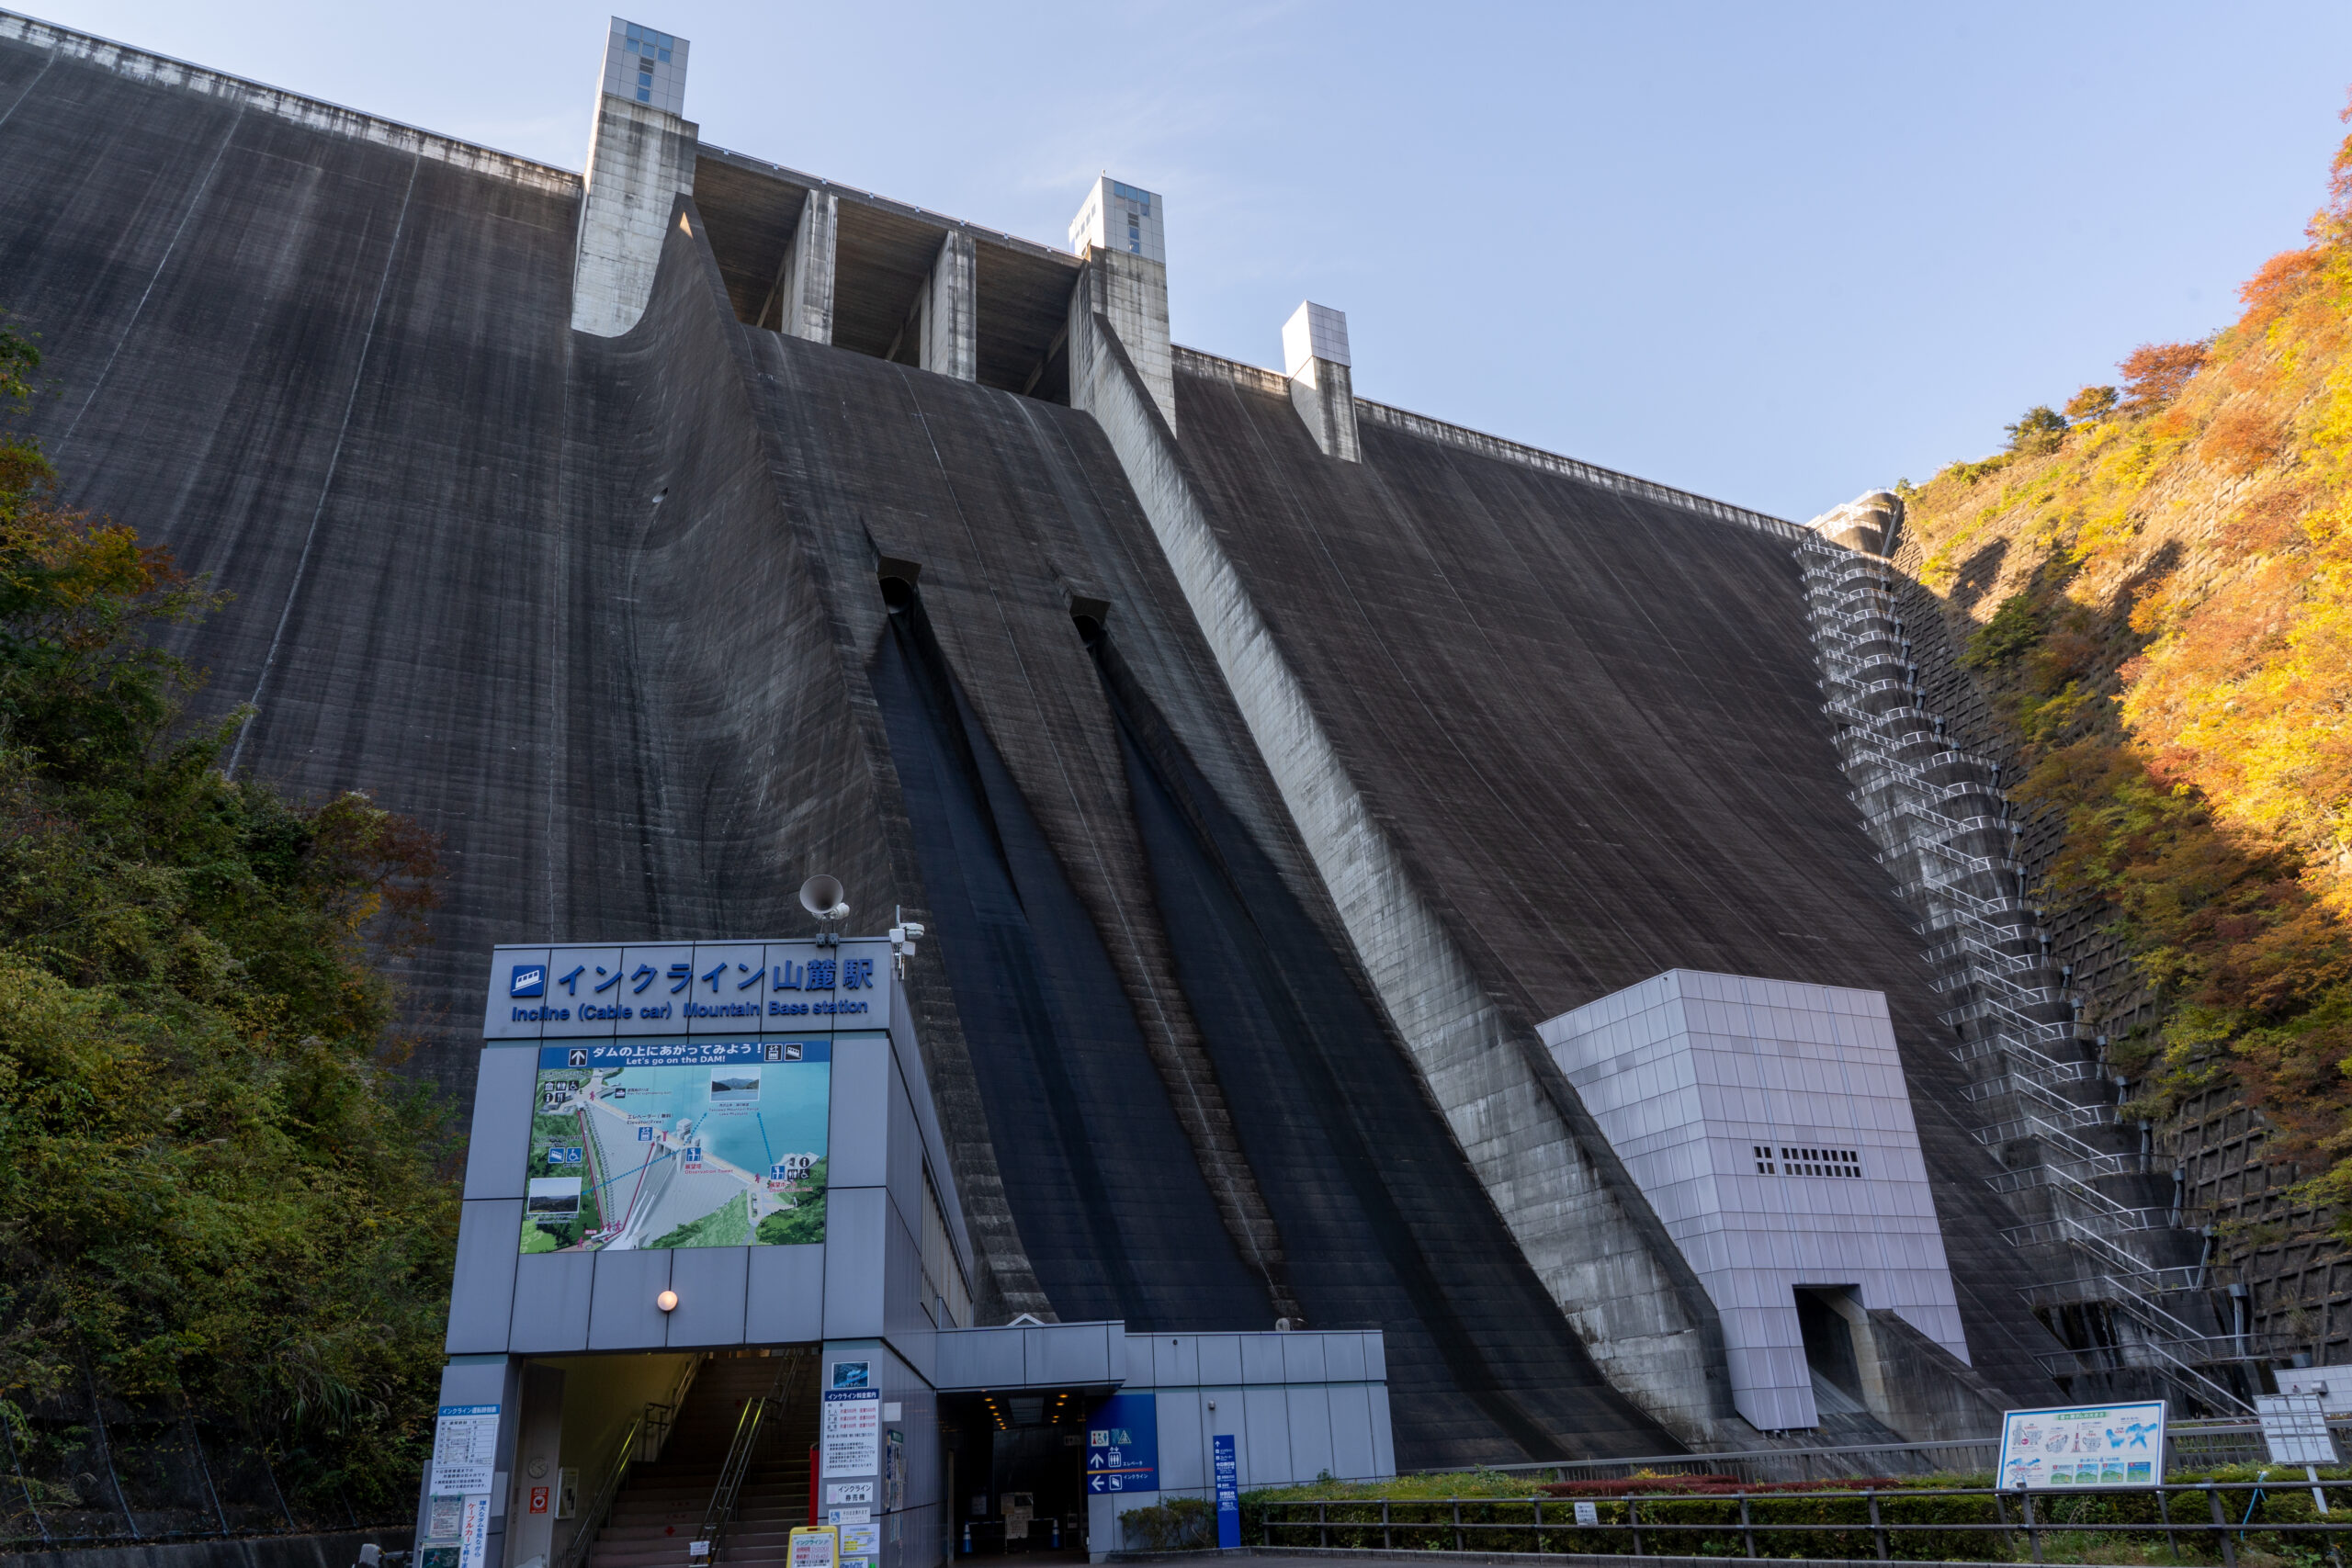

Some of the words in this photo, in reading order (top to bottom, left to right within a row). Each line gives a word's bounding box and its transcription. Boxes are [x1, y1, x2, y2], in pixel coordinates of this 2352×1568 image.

[559, 958, 874, 997] インクライン山麓駅
[512, 1006, 571, 1021] Incline
[578, 1002, 633, 1021] (Cable
[639, 1000, 673, 1020] car)
[683, 1001, 761, 1018] Mountain
[768, 1000, 809, 1016] Base
[812, 998, 868, 1014] station
[650, 1058, 663, 1066] go
[838, 1484, 871, 1493] インクライン
